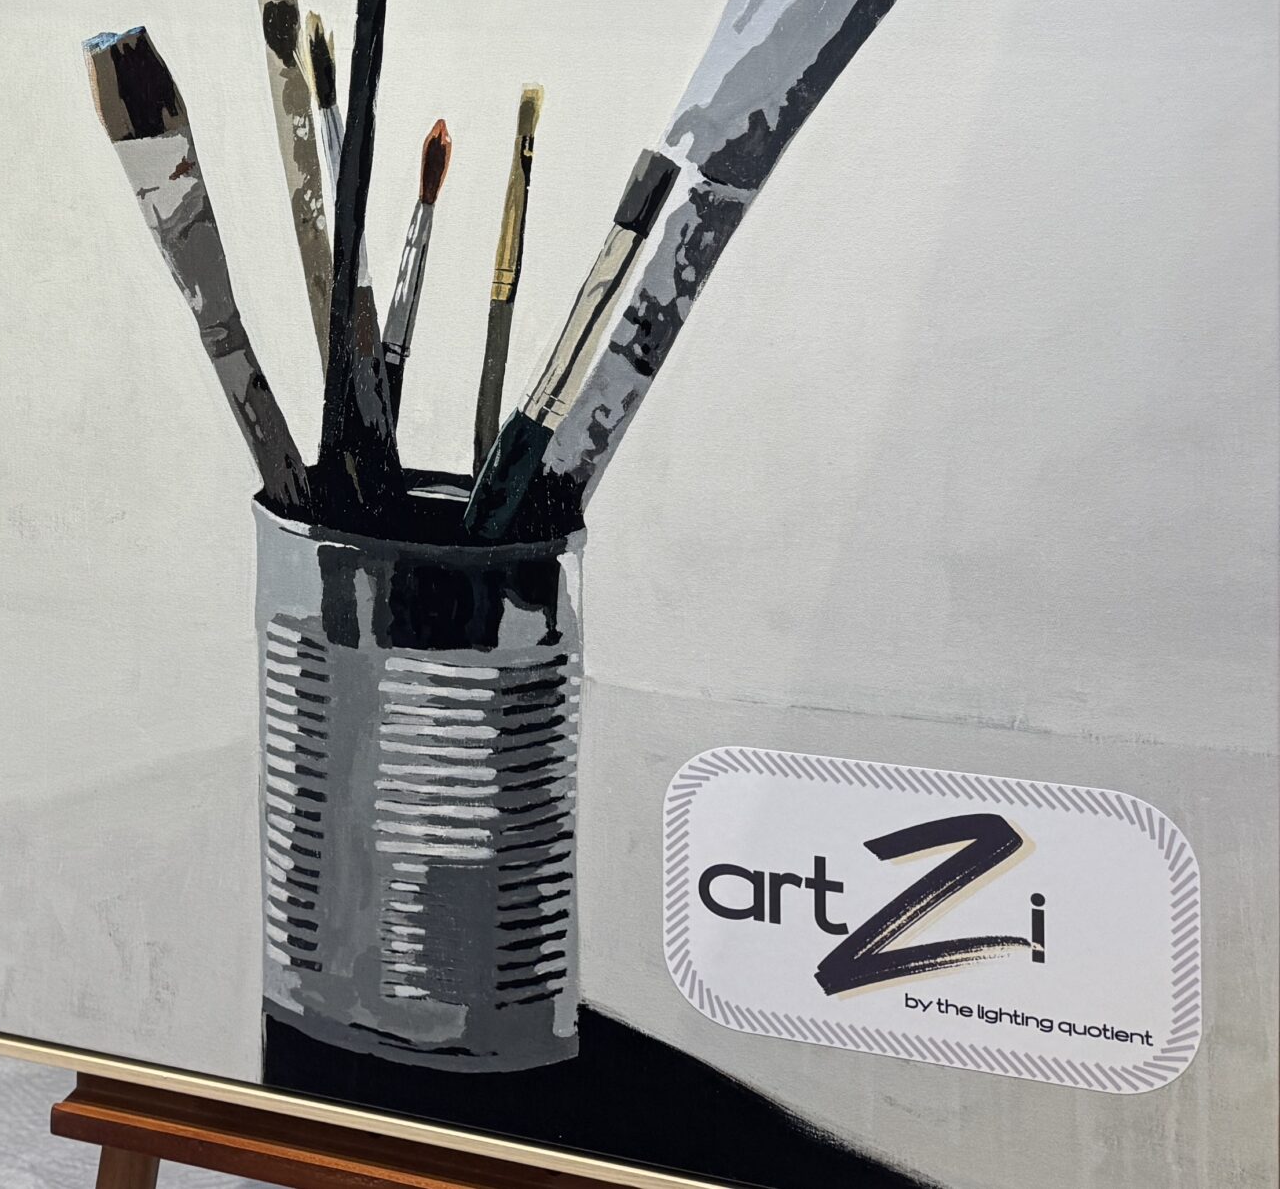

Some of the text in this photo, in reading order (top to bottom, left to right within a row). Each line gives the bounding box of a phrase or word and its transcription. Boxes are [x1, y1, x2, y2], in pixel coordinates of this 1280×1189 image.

[905, 993, 1154, 1047] by the lighting quotient
